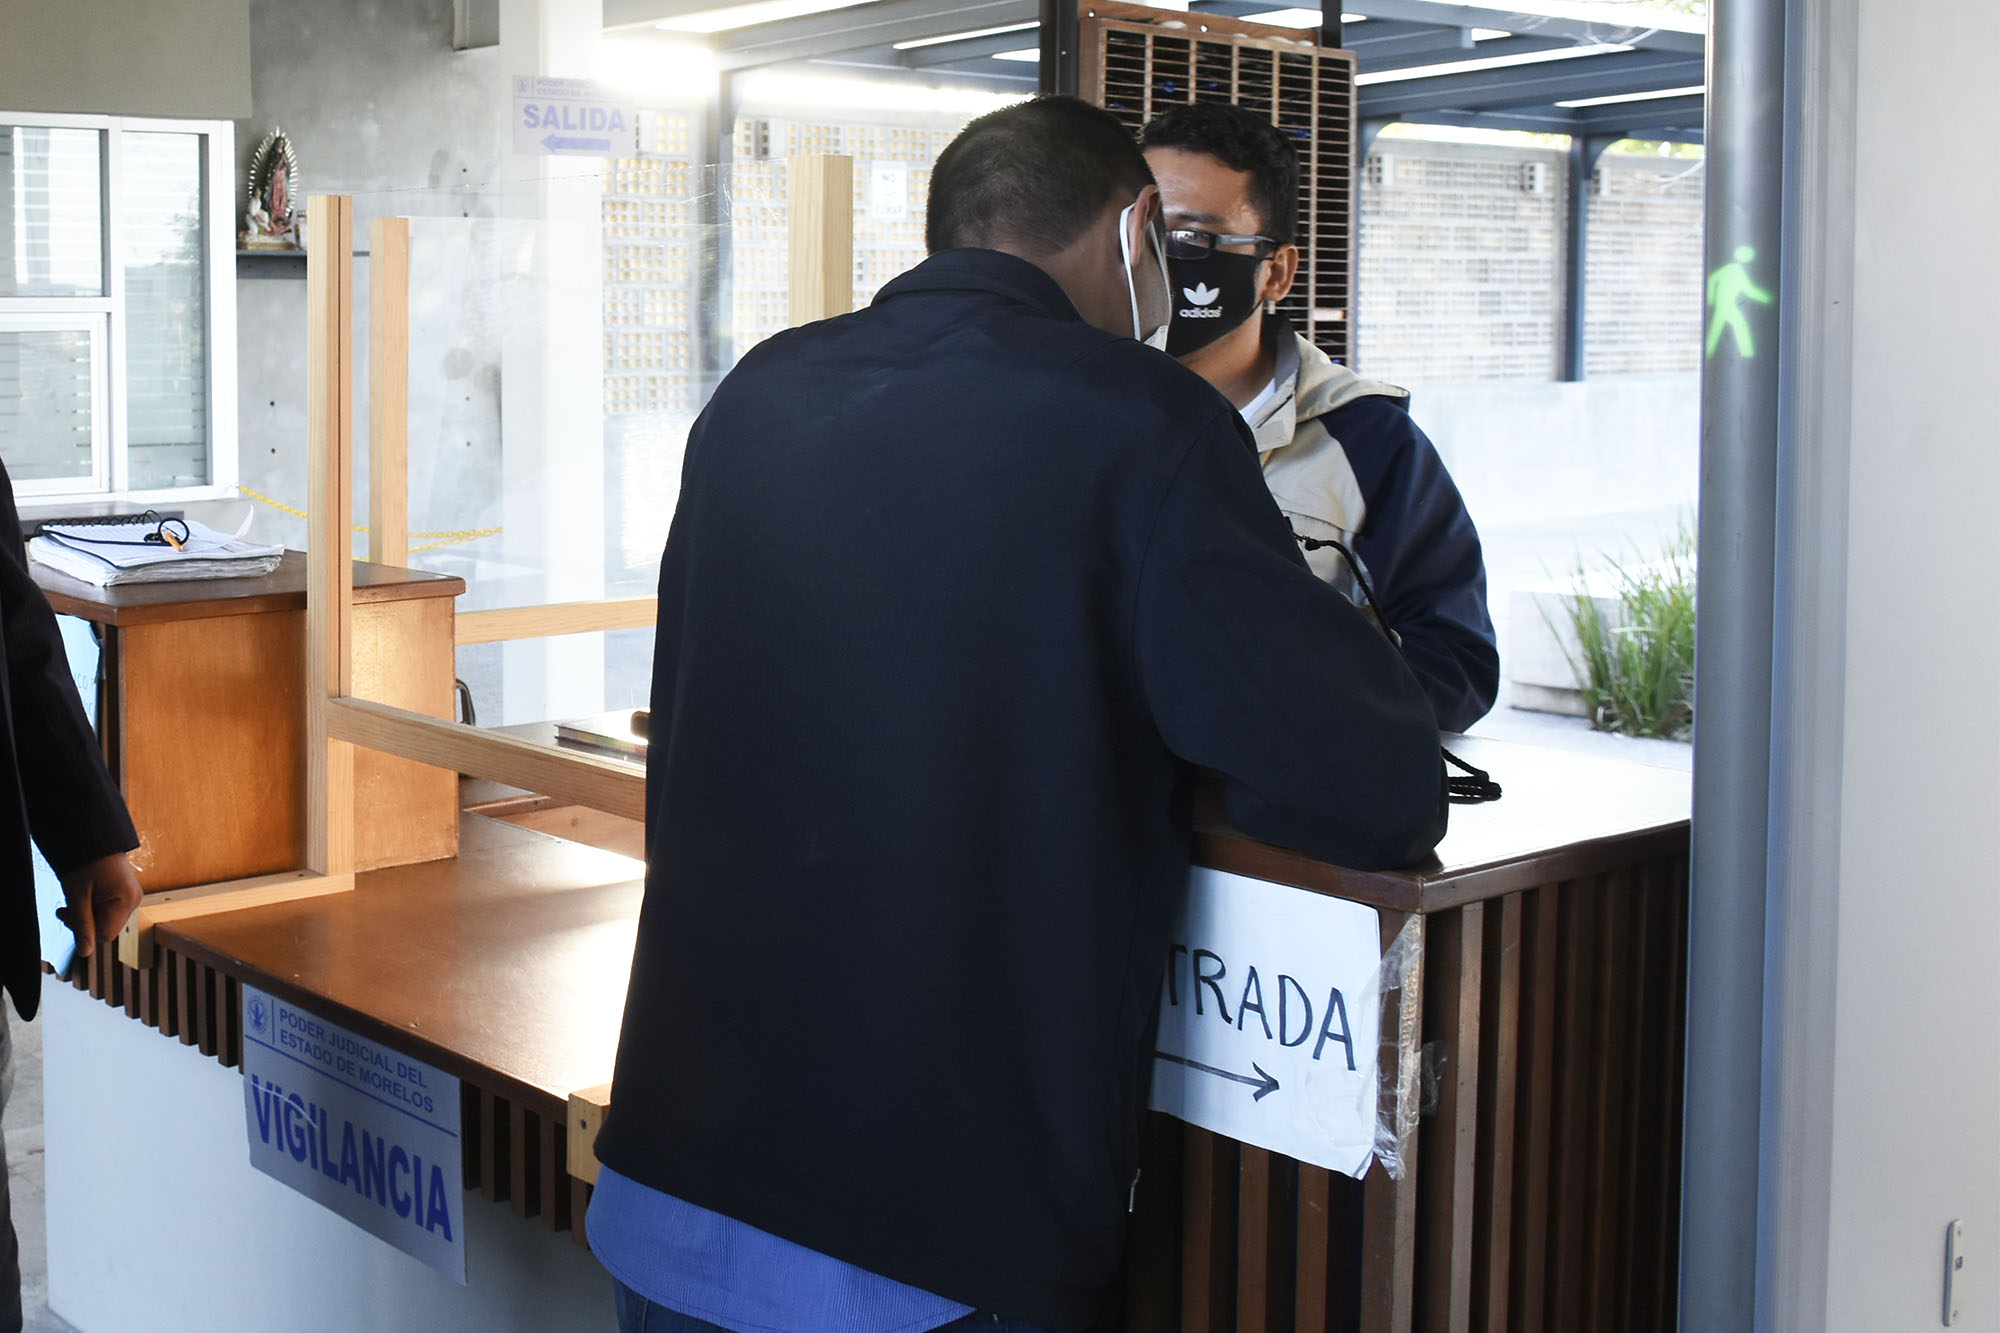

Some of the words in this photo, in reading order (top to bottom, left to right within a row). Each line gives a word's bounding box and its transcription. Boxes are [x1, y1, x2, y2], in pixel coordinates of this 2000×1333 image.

[523, 103, 627, 132] SALIDA
[1179, 307, 1221, 318] adidas
[280, 1007, 325, 1043] PODER
[328, 1032, 393, 1074] JUDICIAL
[397, 1061, 427, 1089] DEL
[280, 1029, 332, 1066] ESTADO
[337, 1055, 355, 1078] DE
[360, 1066, 433, 1114] MORELOS
[252, 1073, 453, 1243] VIGILANCIA
